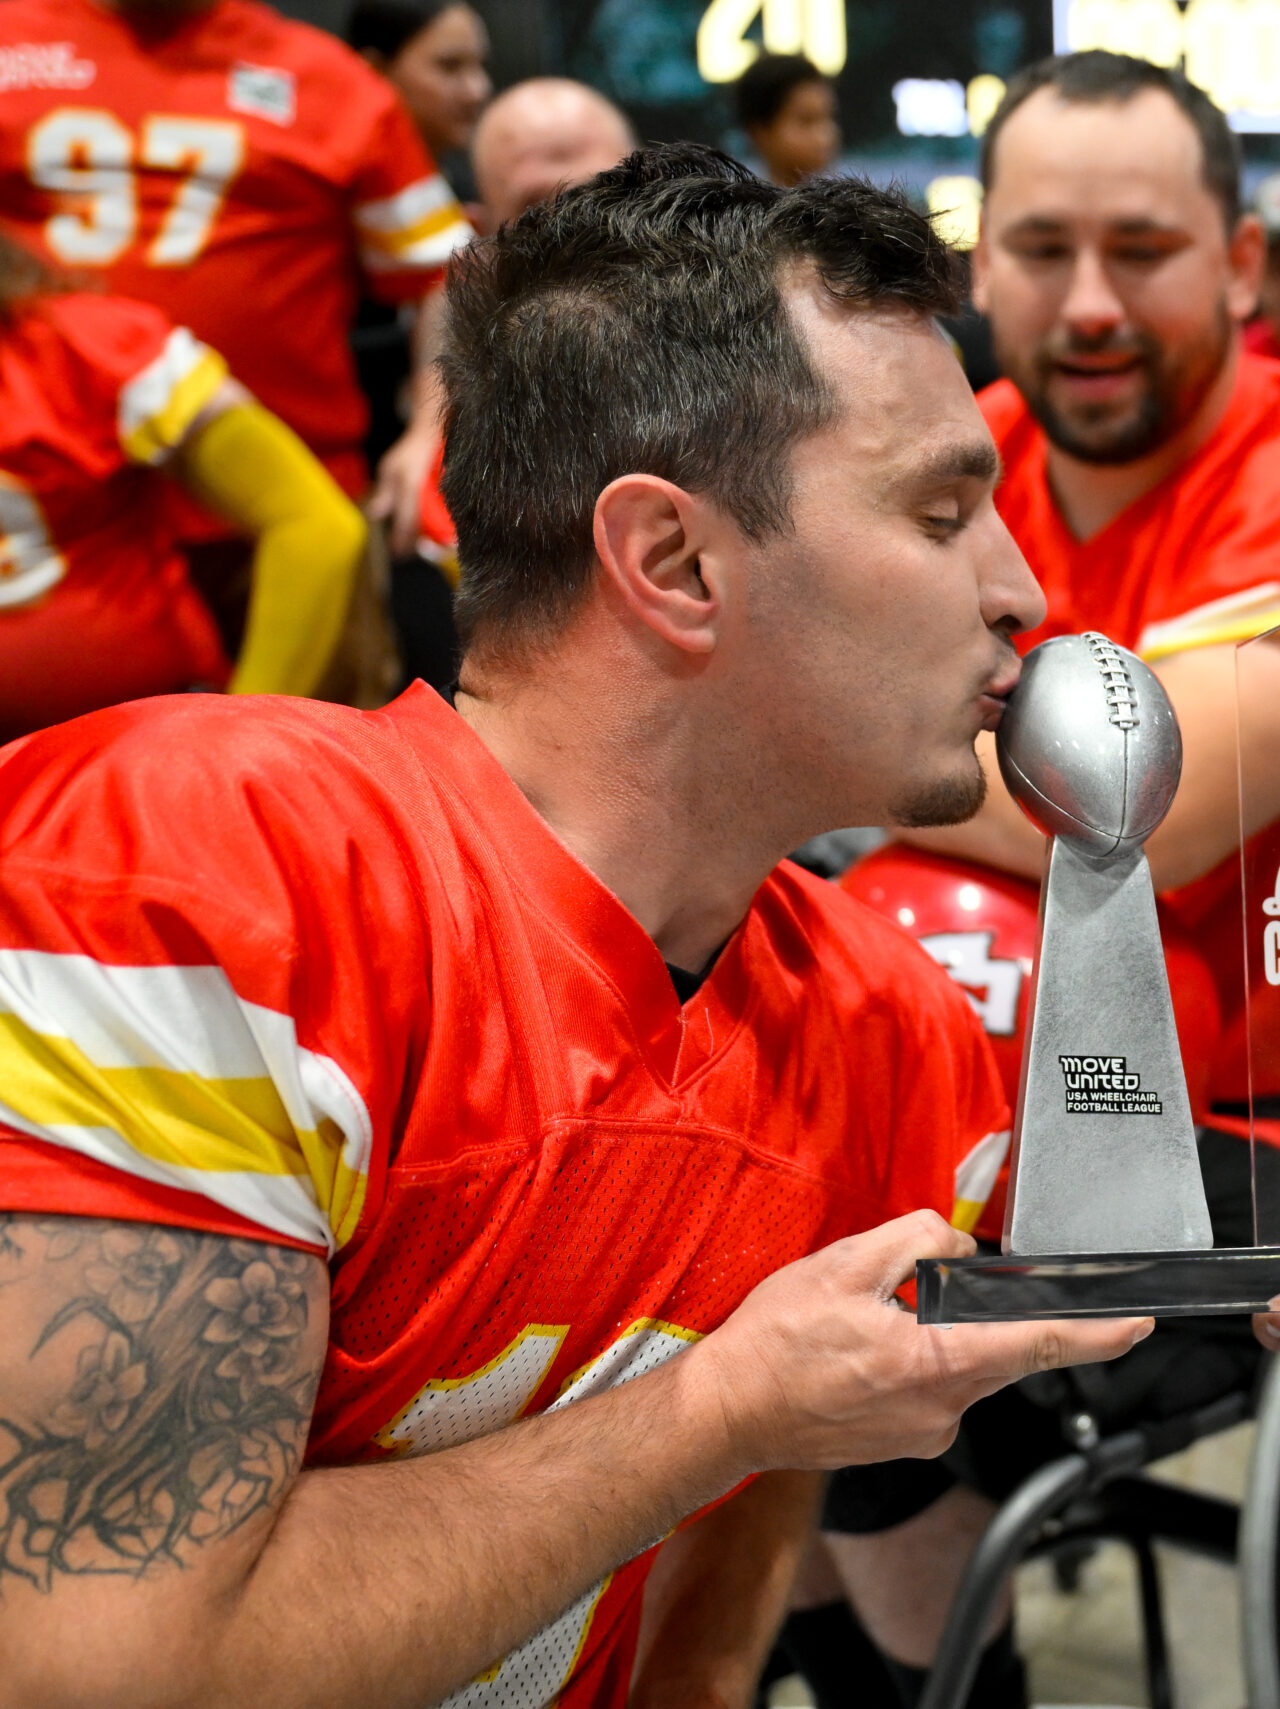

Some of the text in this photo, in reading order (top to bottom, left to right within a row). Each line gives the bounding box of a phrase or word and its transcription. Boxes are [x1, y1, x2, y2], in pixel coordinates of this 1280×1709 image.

[26, 106, 245, 267] 97
[1060, 1057, 1124, 1073] MOVE
[1066, 1073, 1139, 1090] UNITED
[1067, 1091, 1157, 1102] USA WHEELCHAIR
[1067, 1102, 1161, 1113] FOOTBALL LEAGUE
